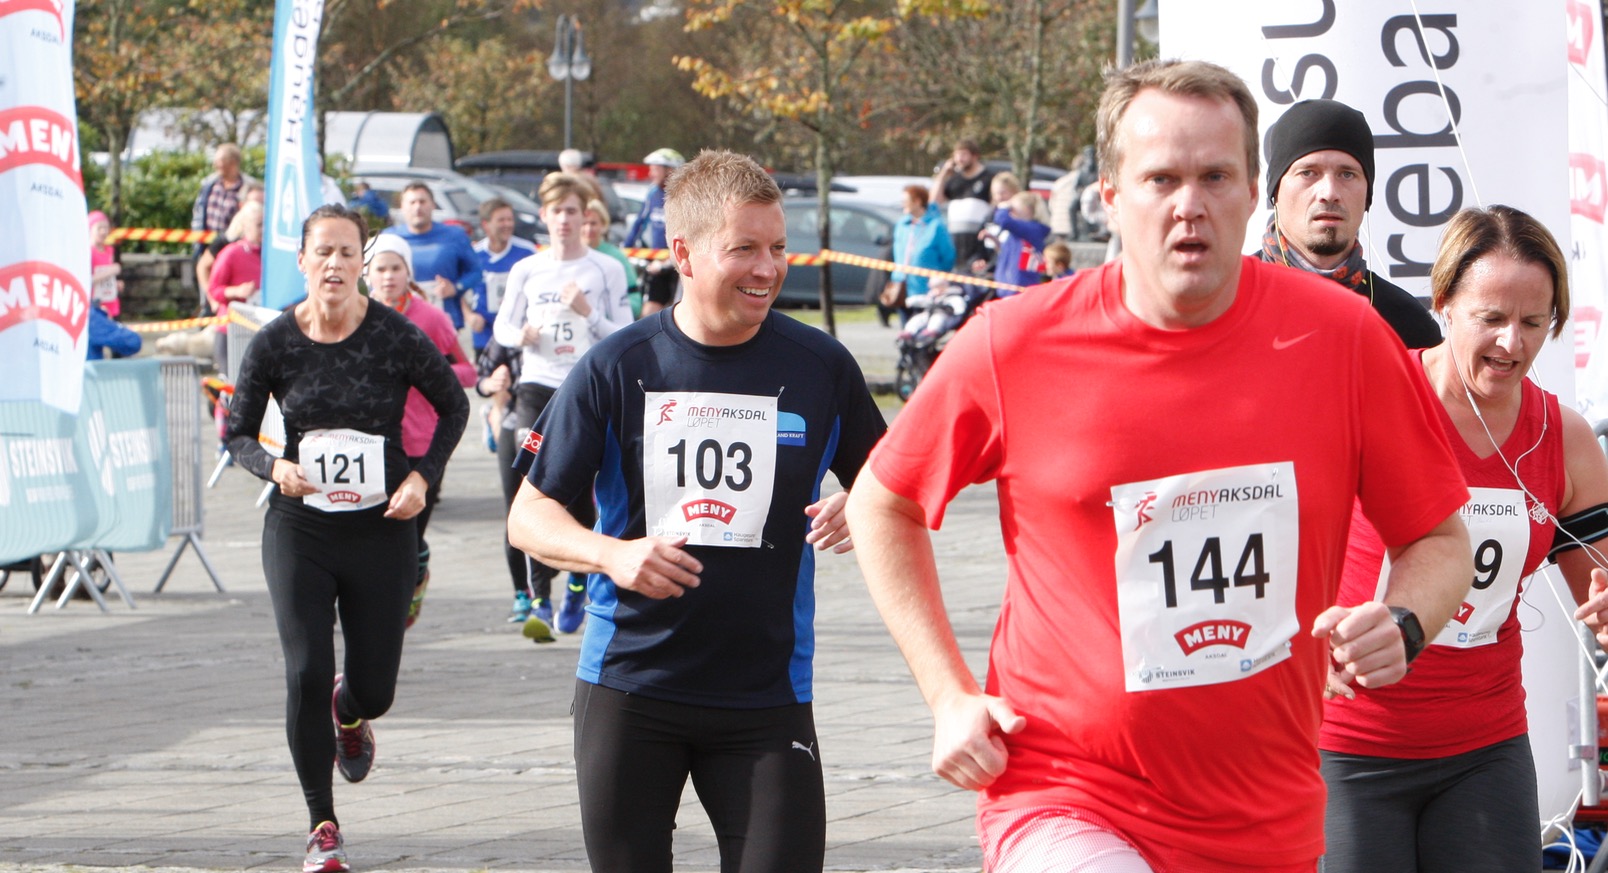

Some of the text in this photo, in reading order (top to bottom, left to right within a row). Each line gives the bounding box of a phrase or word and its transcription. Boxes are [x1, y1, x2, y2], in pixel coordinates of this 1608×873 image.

[285, 0, 309, 144] Hauge
[0, 273, 84, 326] MENY
[550, 322, 574, 343] 75
[687, 406, 768, 421] MENYAKSDAL
[687, 417, 721, 428] LØPET
[315, 453, 365, 484] 121
[668, 438, 753, 492] 103
[330, 492, 359, 503] MENY
[1172, 484, 1284, 508] MENYAKSDAL
[686, 503, 732, 519] MENY
[1171, 504, 1219, 523] LØPET
[1148, 532, 1271, 609] 144
[1183, 624, 1245, 649] MENY
[1155, 668, 1196, 679] STEINSVIK
